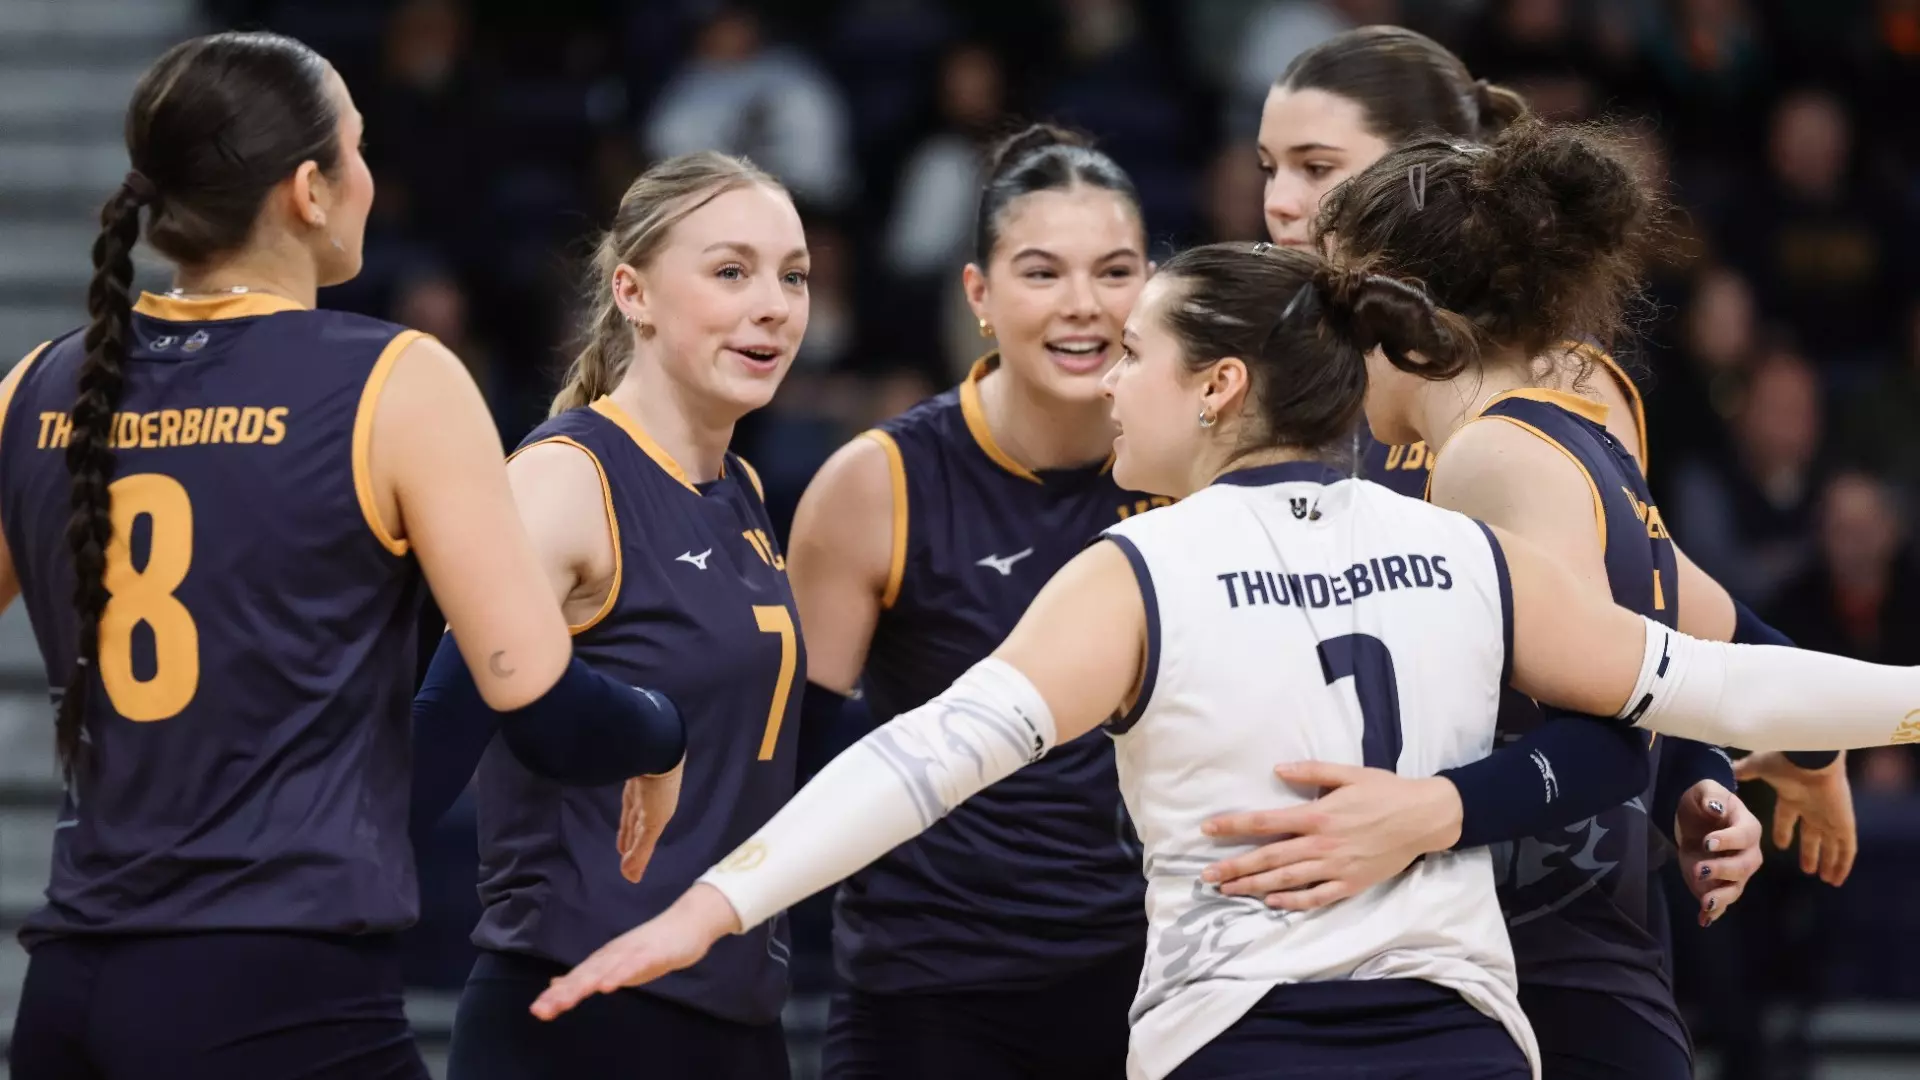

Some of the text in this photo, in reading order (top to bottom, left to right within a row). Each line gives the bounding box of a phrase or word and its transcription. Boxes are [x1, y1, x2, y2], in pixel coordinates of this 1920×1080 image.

[37, 407, 289, 449] THDERBIRDS
[98, 473, 199, 722] 8
[1217, 554, 1453, 609] THUNDEBIRDS
[752, 604, 797, 761] 7
